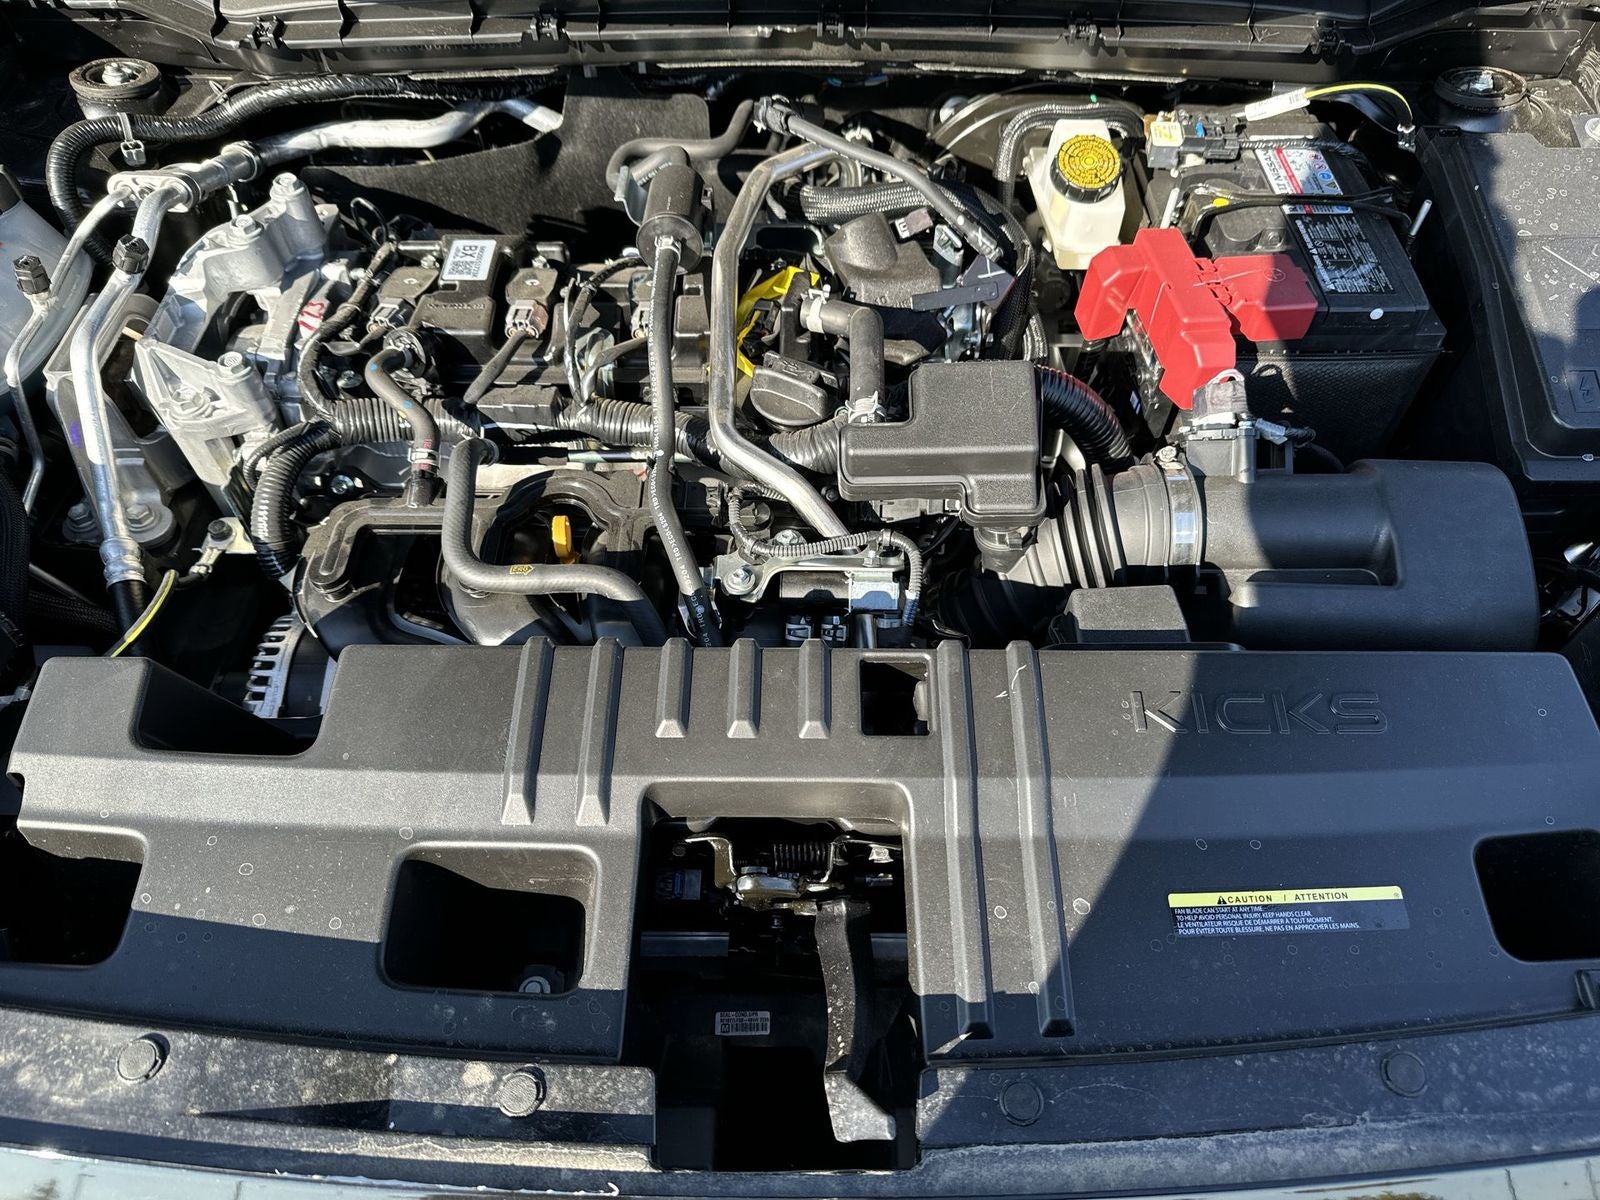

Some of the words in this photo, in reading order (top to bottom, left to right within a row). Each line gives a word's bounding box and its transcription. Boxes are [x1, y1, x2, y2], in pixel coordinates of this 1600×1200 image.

[1131, 690, 1387, 734] KICKS
[1227, 895, 1273, 903] CAUTION
[1294, 892, 1349, 901] ATTENTION
[1184, 920, 1222, 928] VENTILATEUR
[1329, 922, 1339, 930] LES
